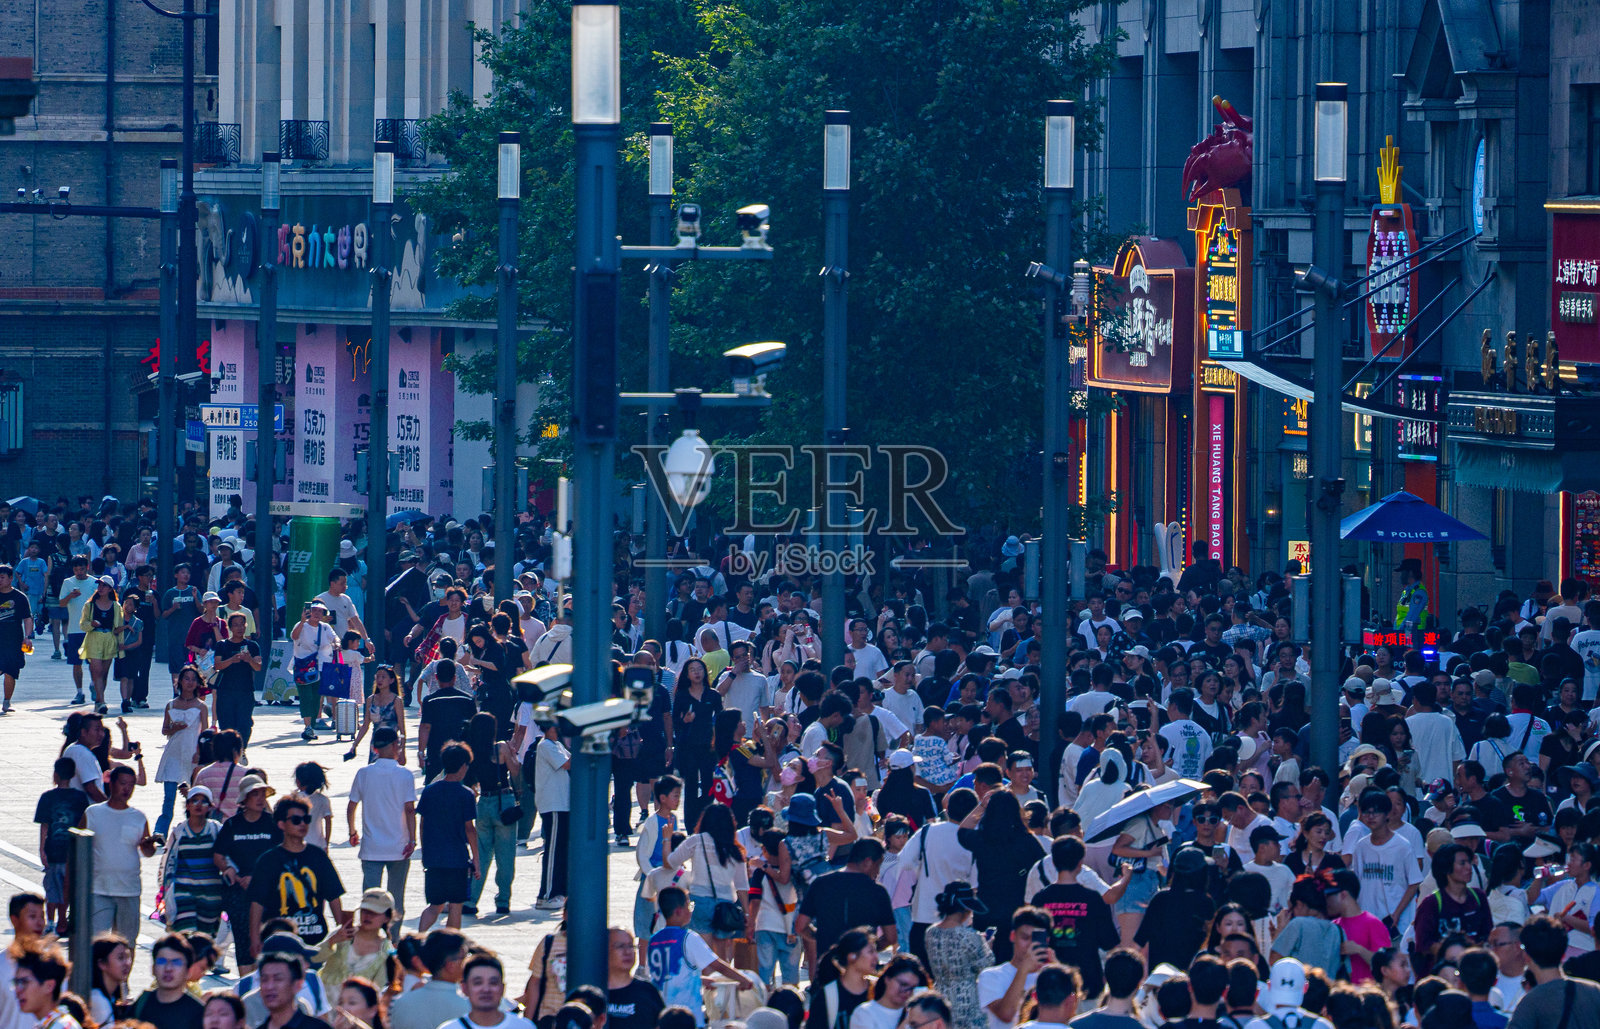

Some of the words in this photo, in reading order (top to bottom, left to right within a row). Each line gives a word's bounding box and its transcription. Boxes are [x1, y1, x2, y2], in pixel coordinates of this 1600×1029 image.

[277, 222, 368, 269] 巧克力大世界
[1556, 259, 1599, 287] 上海特产超市
[303, 408, 326, 436] 巧克力
[396, 414, 421, 442] 巧克力
[1212, 423, 1221, 441] XIE
[216, 434, 237, 461] 博物馆
[303, 438, 326, 466] 博物馆
[1212, 444, 1221, 483] HUANG
[1212, 488, 1221, 519] TANG
[1212, 524, 1220, 547] BAO
[1391, 530, 1434, 539] POLICE
[1423, 632, 1440, 646] 遵
[1049, 909, 1088, 917] UMMER
[650, 946, 672, 981] 91
